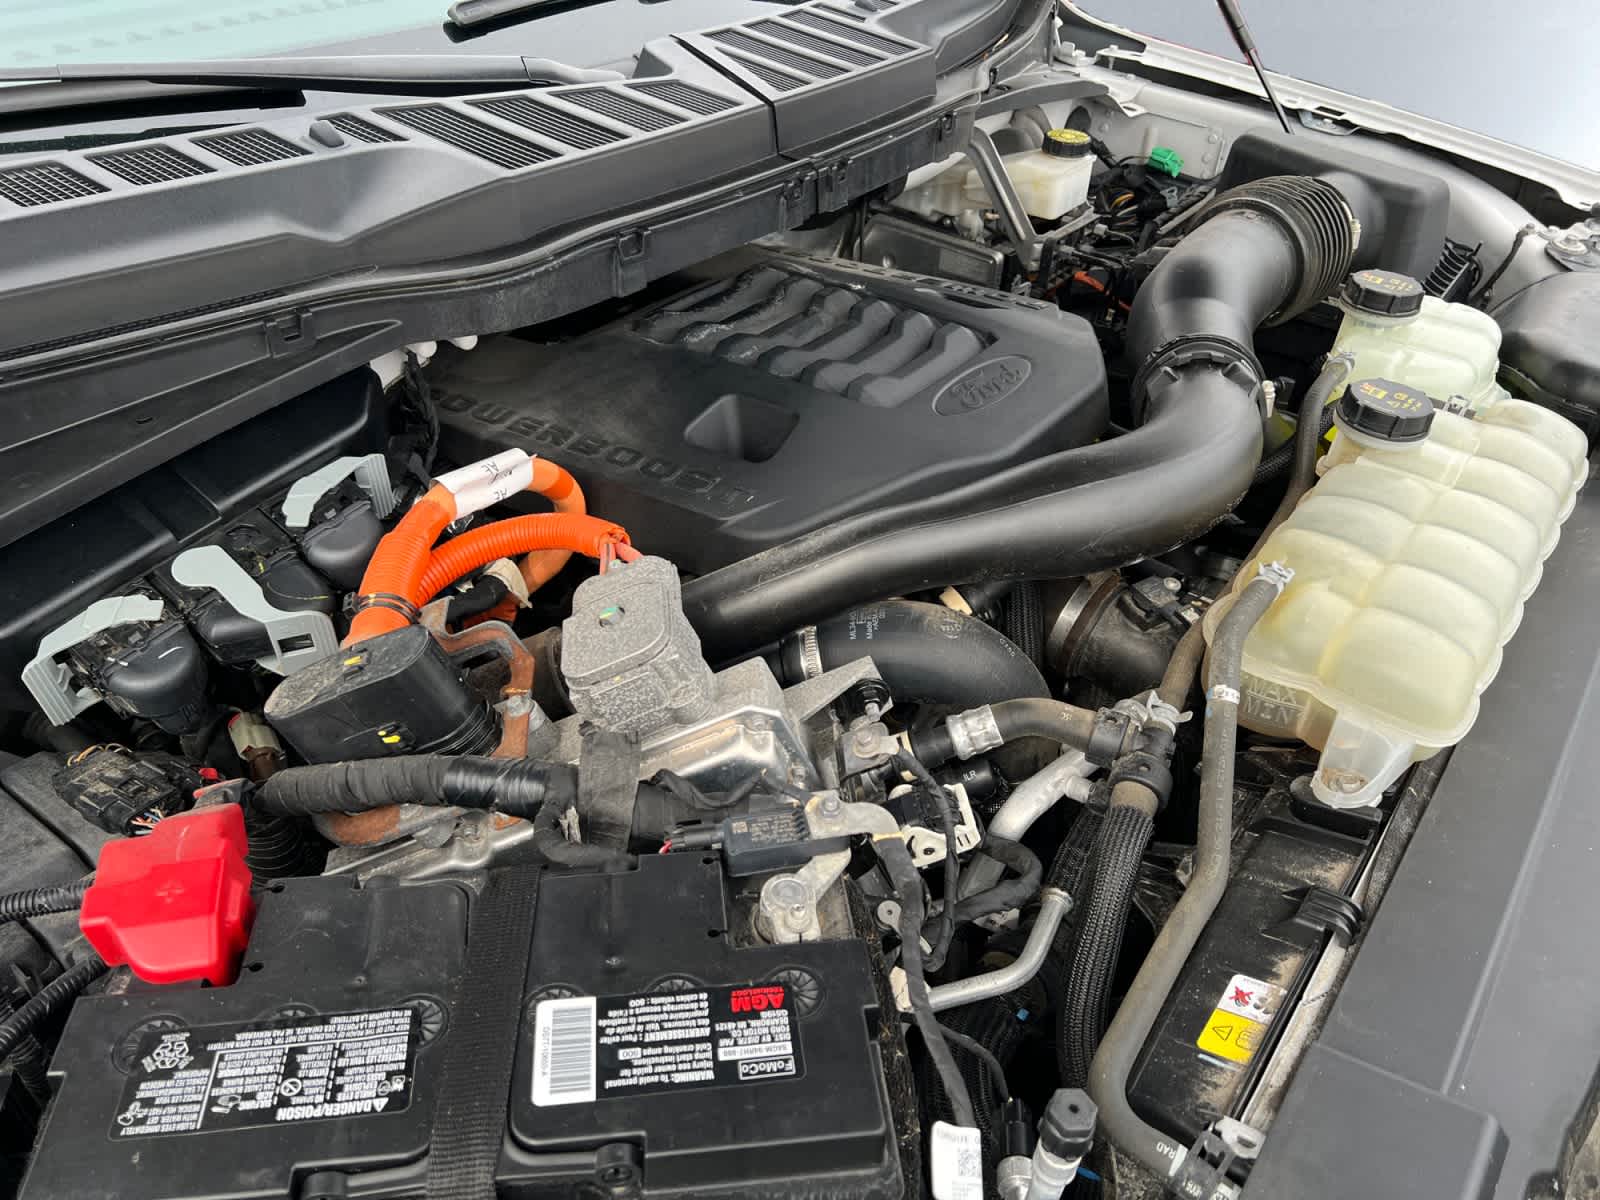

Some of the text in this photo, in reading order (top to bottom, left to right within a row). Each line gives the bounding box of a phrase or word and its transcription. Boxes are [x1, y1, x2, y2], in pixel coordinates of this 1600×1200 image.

[950, 363, 1024, 409] Ford
[730, 992, 785, 1013] AGM
[615, 1023, 635, 1034] guide
[643, 1026, 710, 1042] AVERTISSEMENT
[742, 1026, 769, 1036] MOTOR
[769, 1024, 790, 1033] FORD
[620, 1033, 637, 1043] Pour
[641, 1045, 662, 1055] amps
[662, 1042, 694, 1054] cranking
[694, 1042, 712, 1051] Cold
[675, 1052, 693, 1062] start
[693, 1050, 712, 1060] jump
[631, 1064, 653, 1076] guide
[691, 1058, 713, 1070] injury
[741, 1059, 792, 1075] FoMoCo
[638, 1074, 659, 1085] avoid
[670, 1069, 714, 1083] WARNING:
[604, 1076, 638, 1089] personal
[275, 1098, 372, 1122] DANGER/POISON
